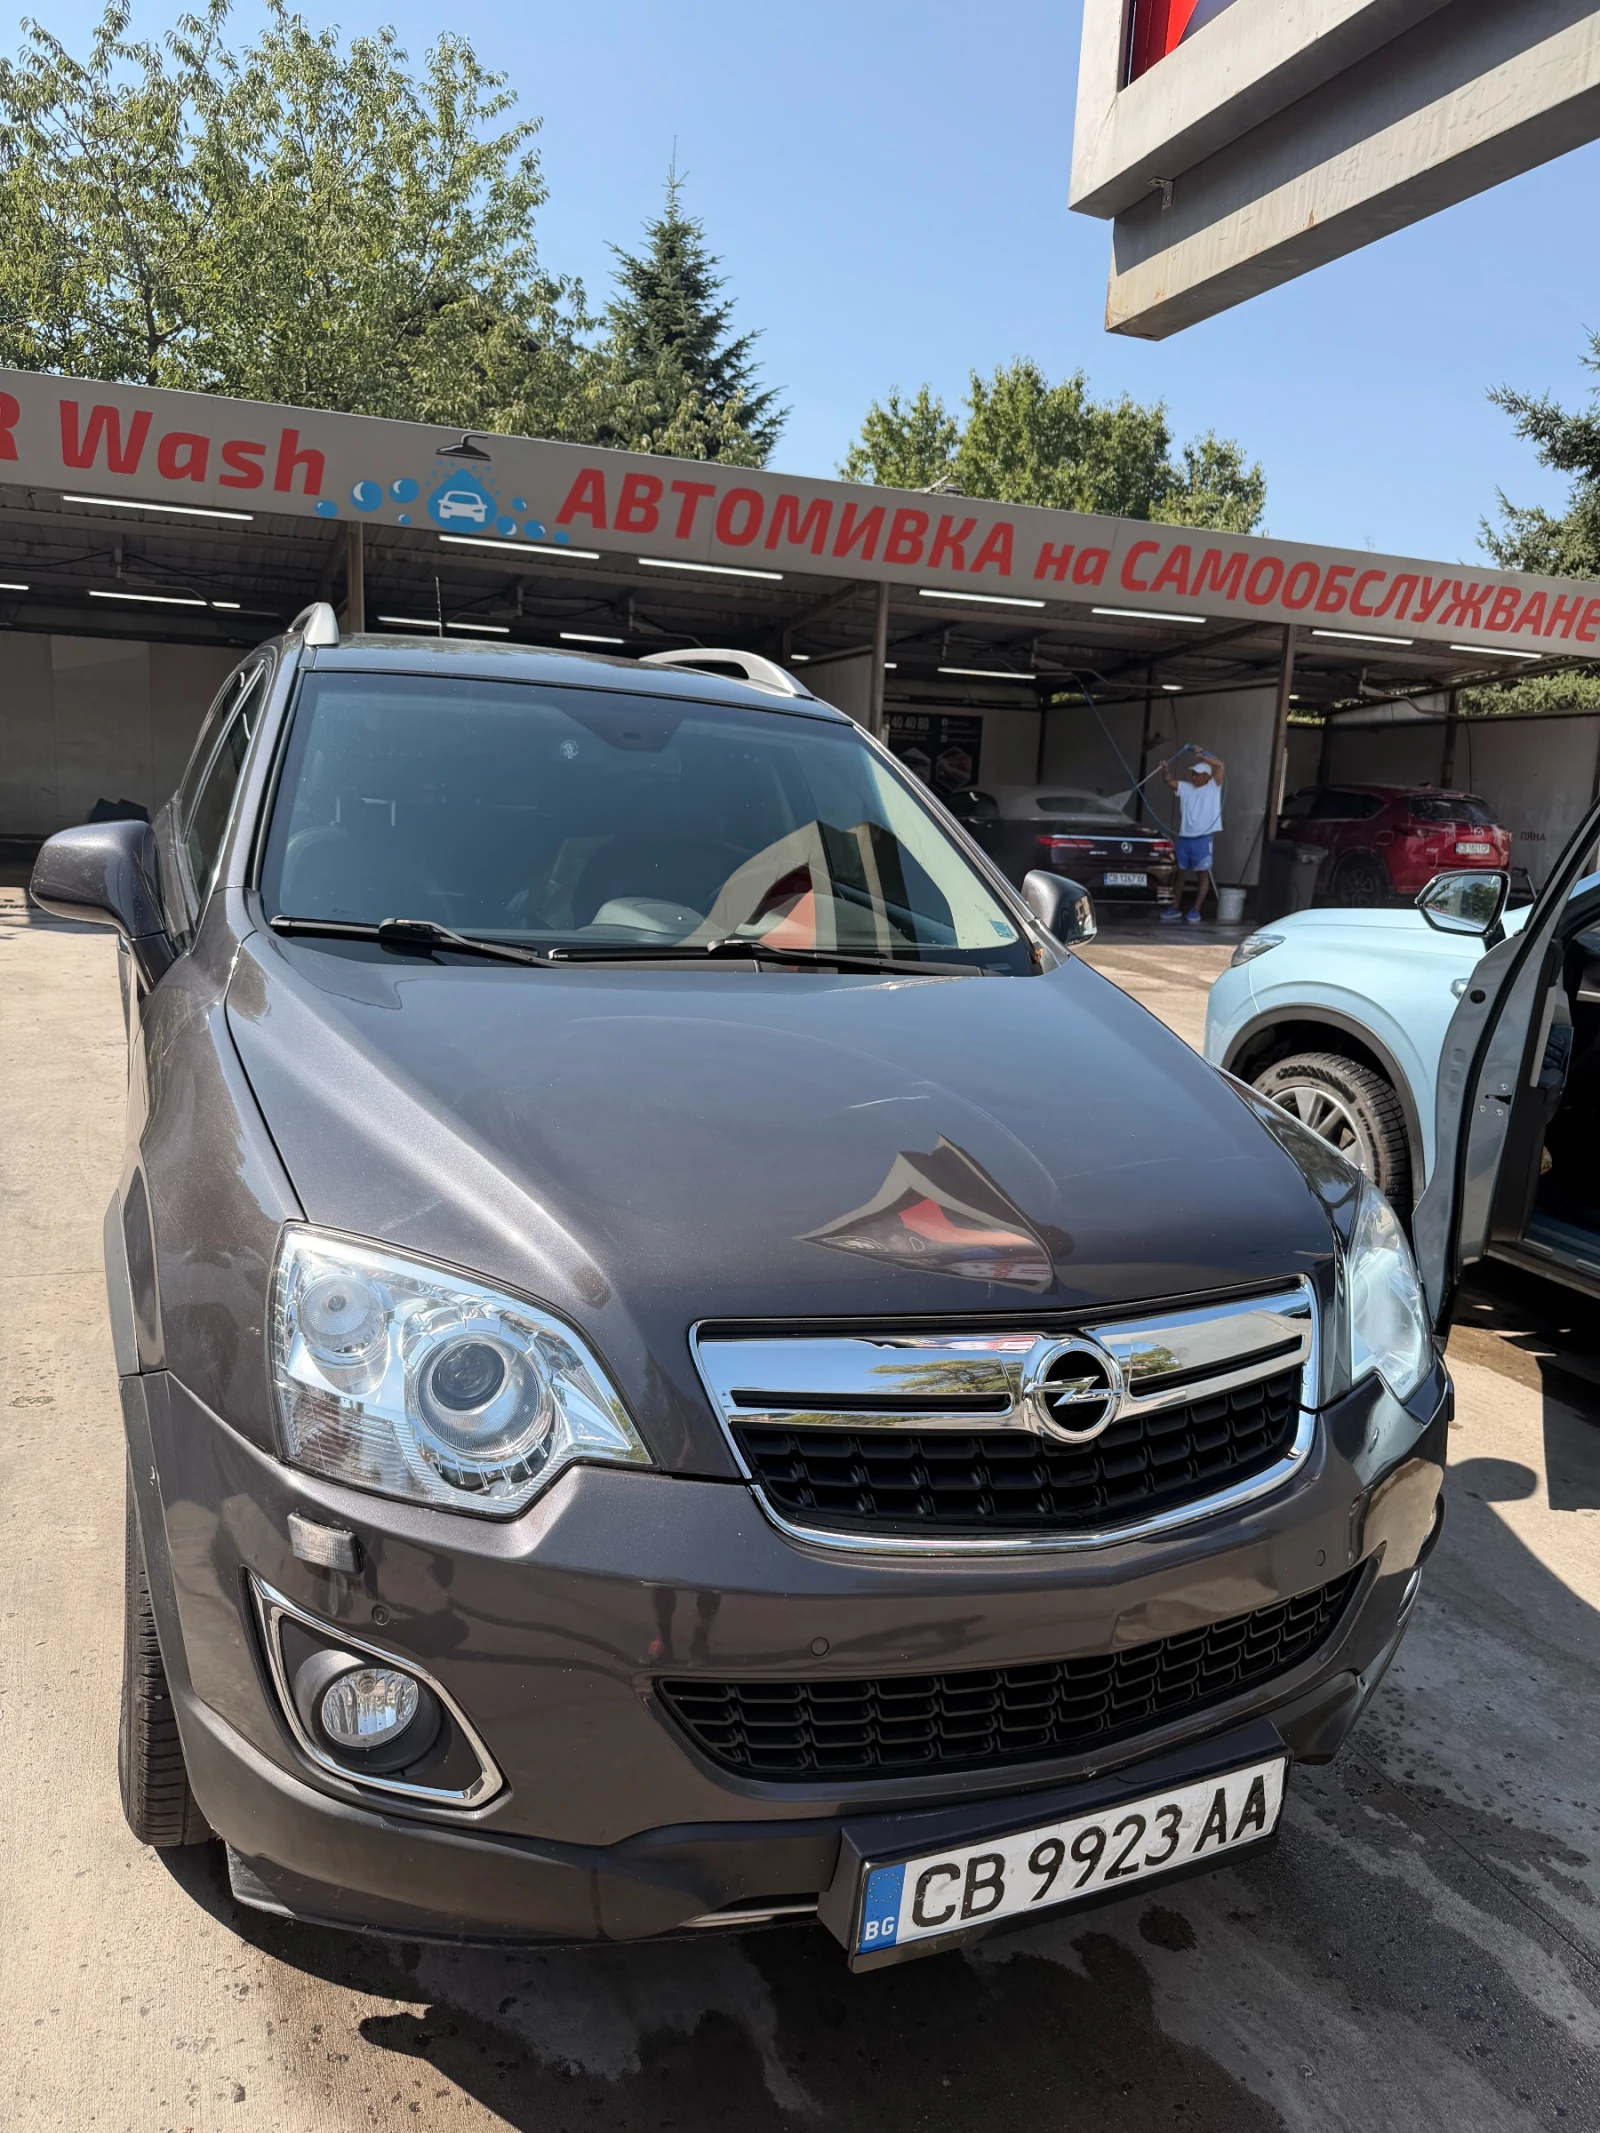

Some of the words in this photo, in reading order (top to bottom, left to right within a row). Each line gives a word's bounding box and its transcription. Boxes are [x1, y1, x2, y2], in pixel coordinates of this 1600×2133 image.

[59, 400, 325, 496] Wash
[555, 468, 1014, 577] АВТОМИВКА
[1033, 542, 1111, 586] на
[1119, 540, 1600, 643] САМООБСЛУЖВАНЕ
[1520, 831, 1546, 841] ПЯНА
[864, 1916, 895, 1941] BG
[911, 1852, 1006, 1928] CB
[1027, 1803, 1183, 1902] 9923
[1191, 1774, 1267, 1854] AA
